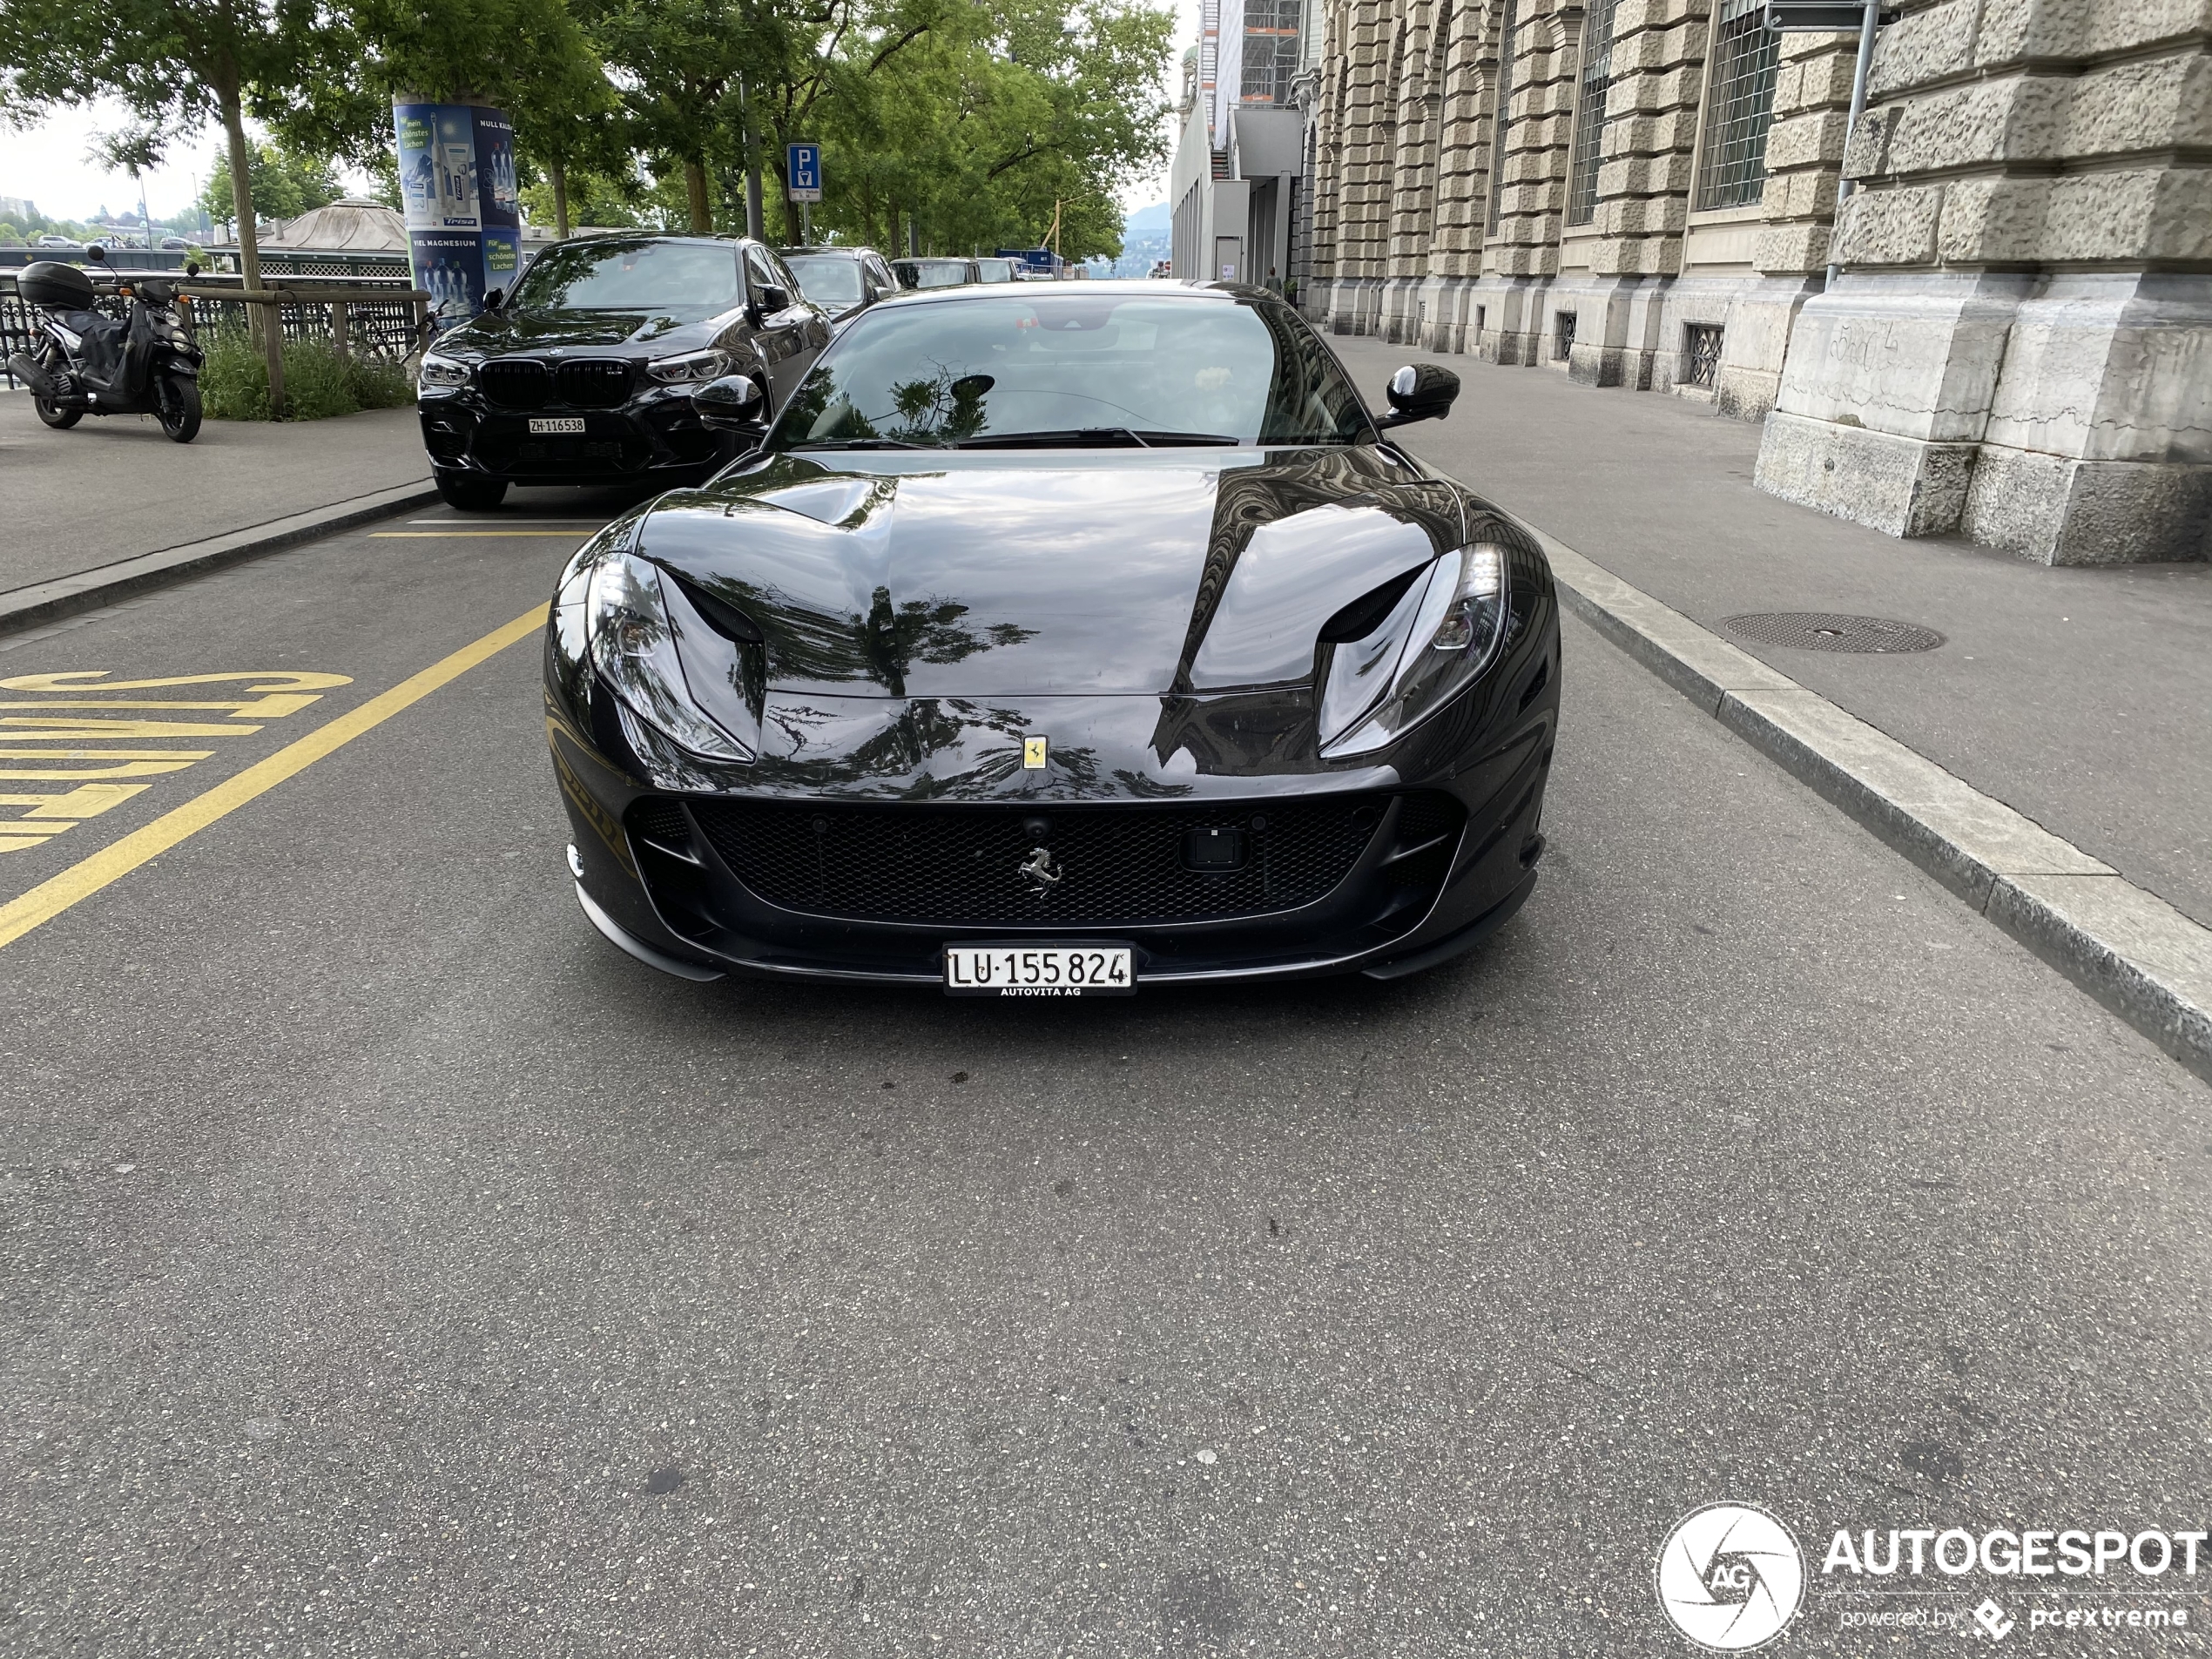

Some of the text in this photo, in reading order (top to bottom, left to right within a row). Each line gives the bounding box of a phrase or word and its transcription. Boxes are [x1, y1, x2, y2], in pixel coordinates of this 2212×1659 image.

[480, 120, 498, 129] NULL
[404, 140, 423, 149] Lachen
[798, 149, 811, 170] P
[1001, 988, 1081, 996] AUTOVITA AG
